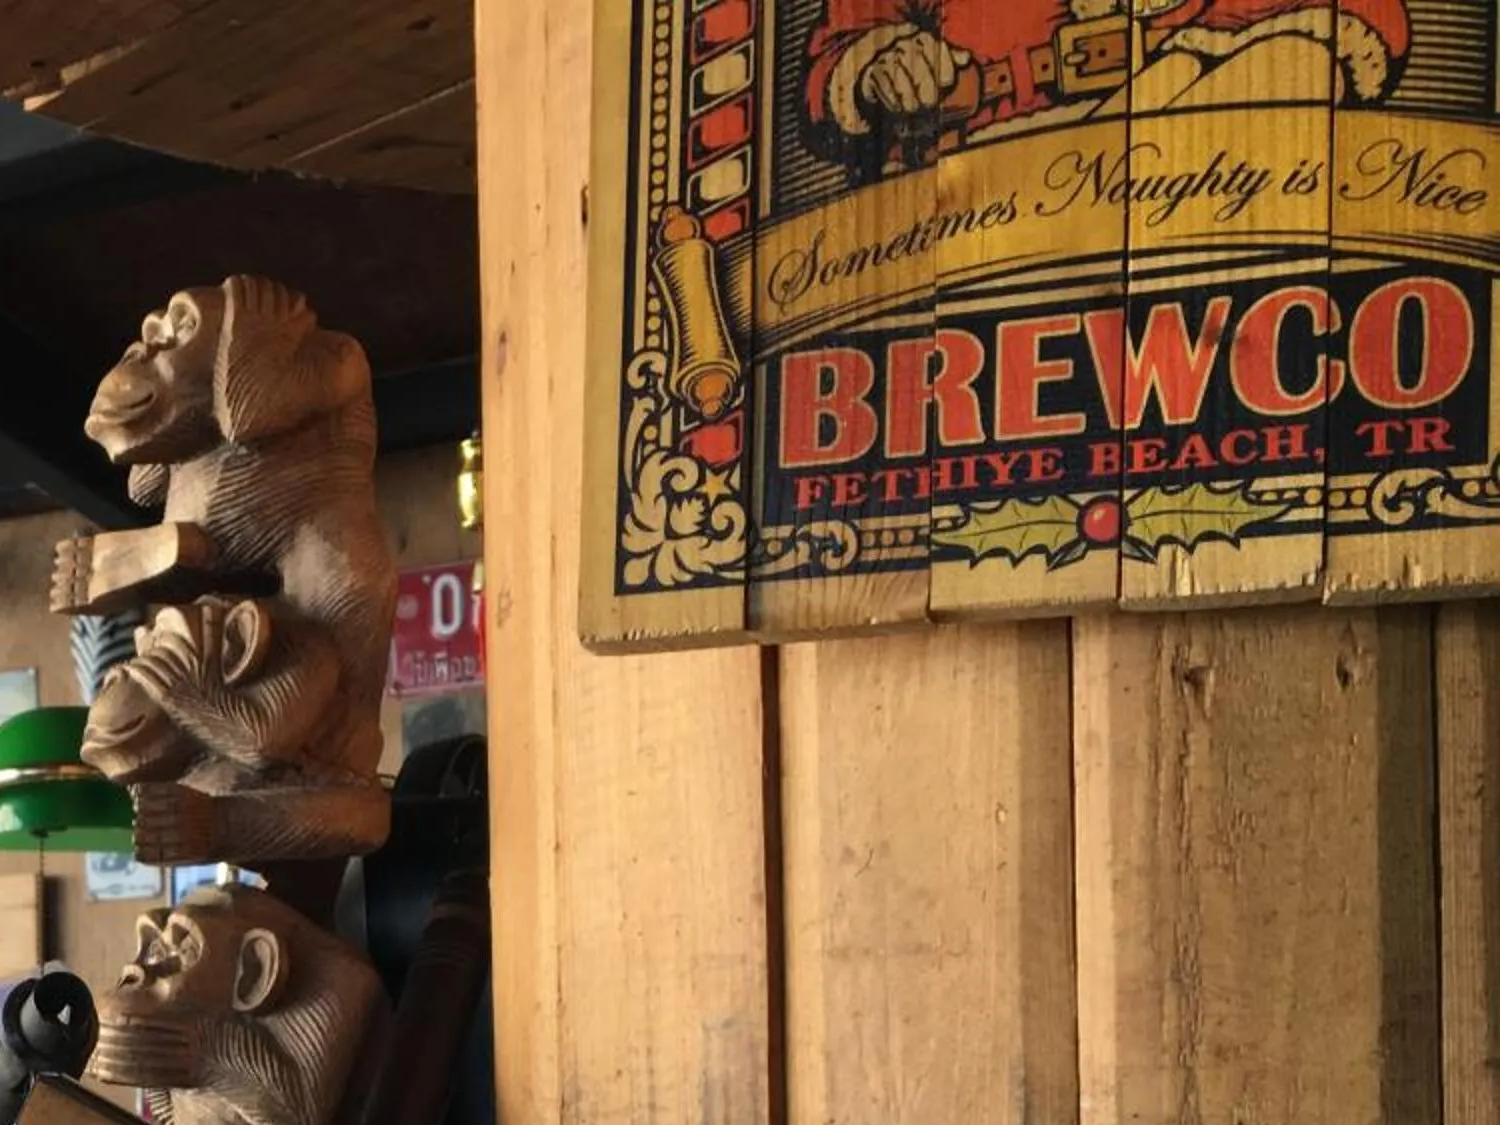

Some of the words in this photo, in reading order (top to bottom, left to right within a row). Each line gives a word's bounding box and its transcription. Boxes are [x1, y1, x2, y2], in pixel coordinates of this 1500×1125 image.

[768, 193, 1018, 315] Sometimes
[1035, 142, 1275, 227] Naughty
[1281, 159, 1324, 195] is
[1340, 139, 1489, 215] Nice
[778, 275, 1474, 468] BREWCO
[794, 448, 1068, 511] FETHIYE
[1088, 424, 1326, 477] BEACH,
[1355, 416, 1456, 458] TR
